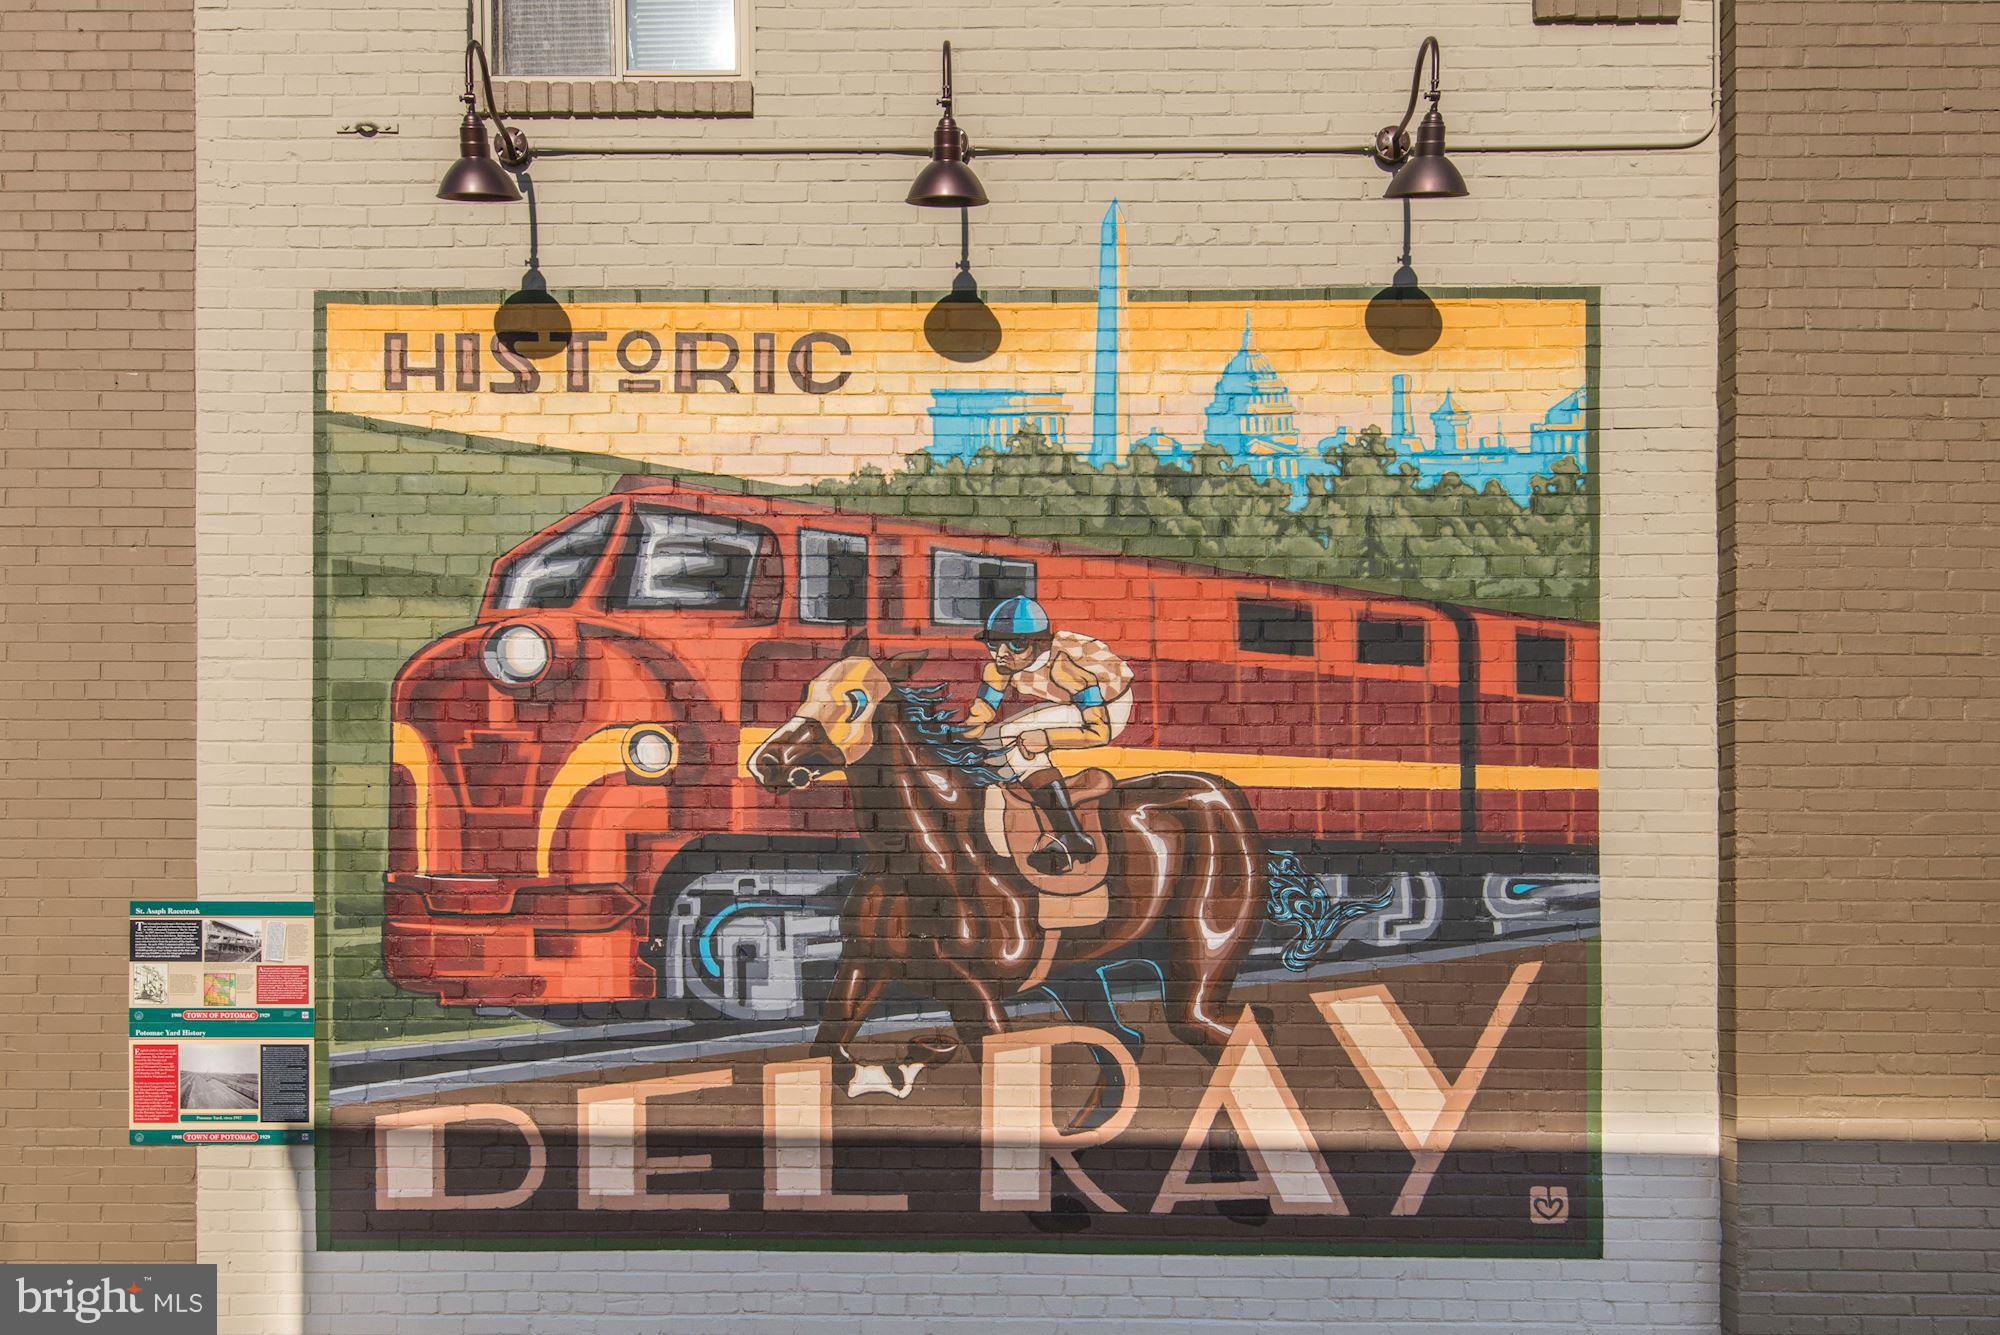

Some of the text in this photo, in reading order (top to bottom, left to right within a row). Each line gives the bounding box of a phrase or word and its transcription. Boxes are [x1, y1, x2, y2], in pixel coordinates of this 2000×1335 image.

[384, 332, 852, 394] HISTORIC
[146, 908, 166, 916] Asaph
[182, 1030, 206, 1038] History
[375, 961, 1542, 1215] DEL RAY
